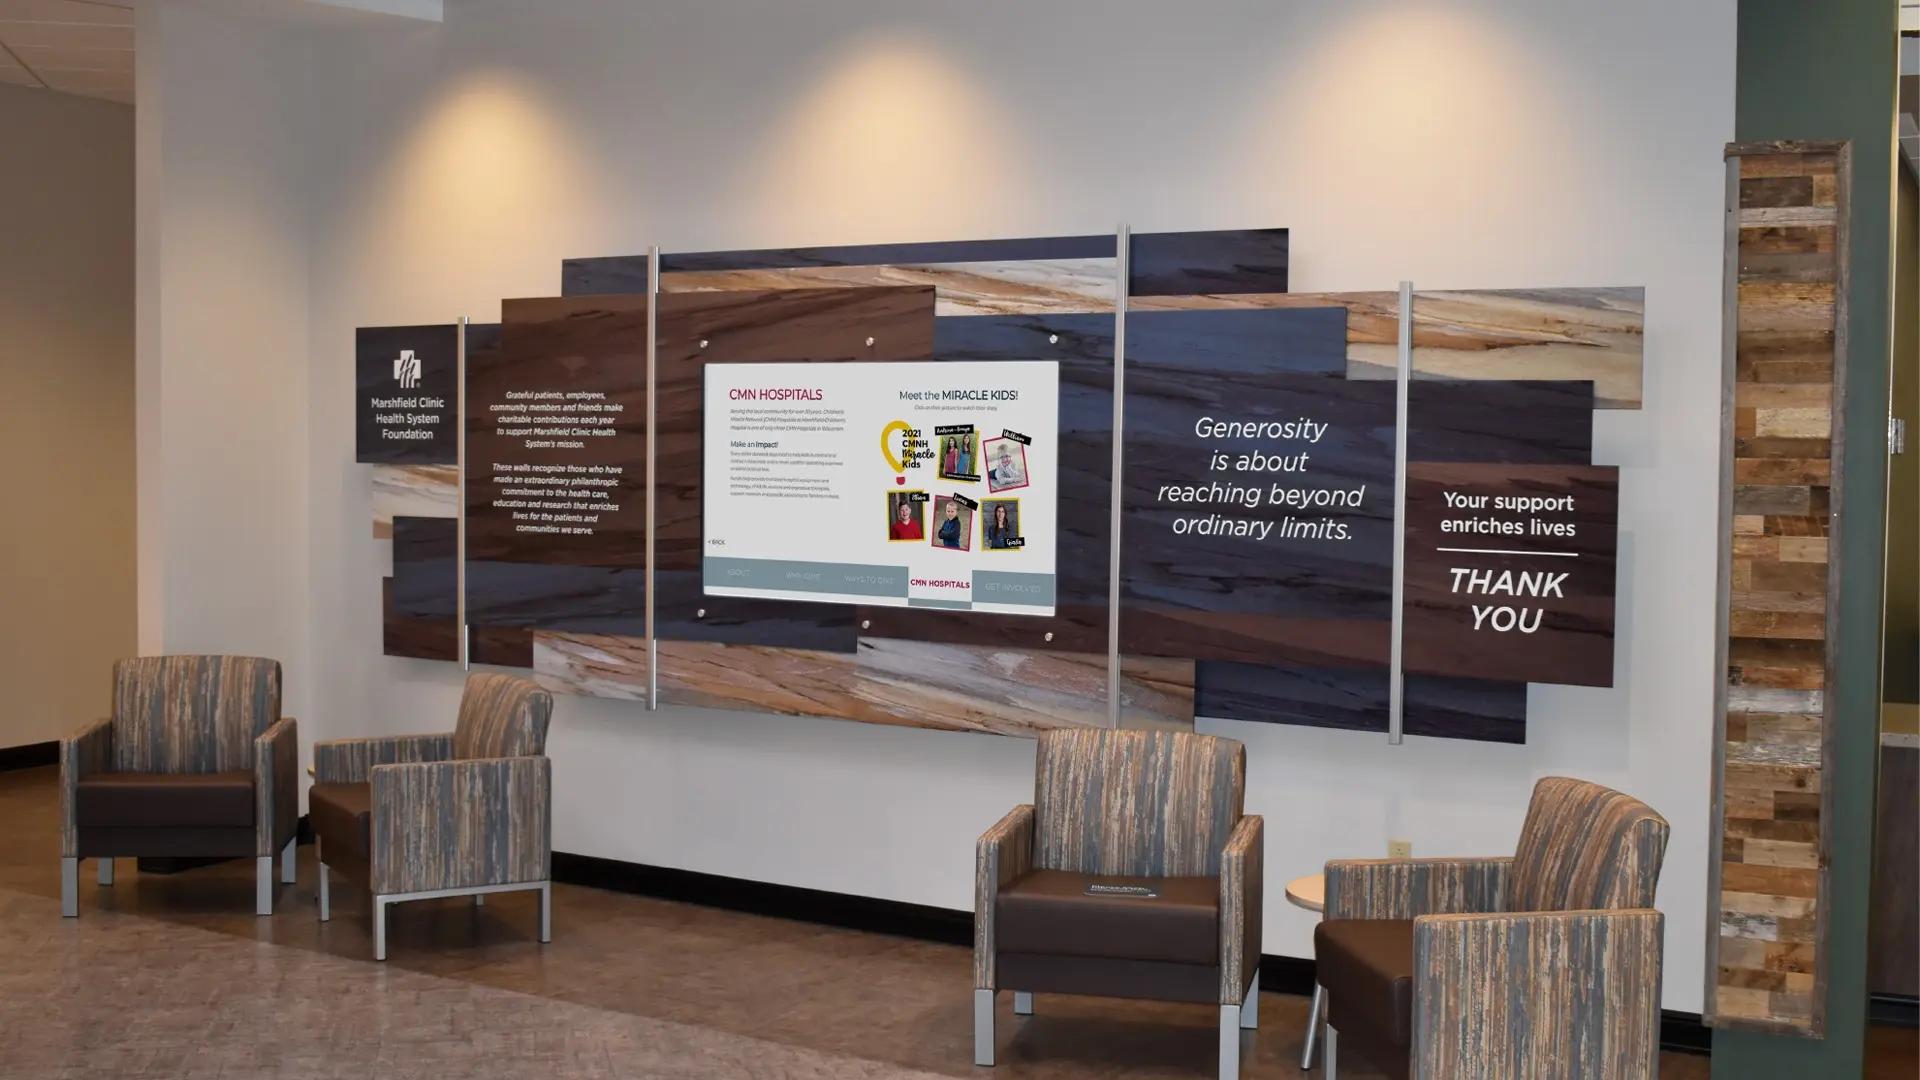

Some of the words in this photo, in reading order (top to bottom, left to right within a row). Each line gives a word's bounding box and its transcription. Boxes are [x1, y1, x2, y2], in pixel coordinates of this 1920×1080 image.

[506, 391, 533, 399] Grateful
[534, 391, 564, 400] patients,
[566, 392, 606, 400] employees,
[729, 389, 756, 400] CMN
[759, 389, 822, 400] HOSPITALS
[900, 391, 922, 400] Meet
[925, 391, 939, 400] the
[942, 390, 988, 400] MIRACLE
[991, 390, 1018, 400] KIDS!
[372, 397, 417, 408] Marshfield
[420, 397, 444, 408] Clinic
[490, 403, 527, 412] community
[376, 413, 404, 423] Health
[407, 413, 440, 425] System
[599, 417, 615, 425] year
[382, 429, 433, 439] Foundation
[506, 428, 532, 437] support
[571, 428, 590, 436] Clinic
[592, 428, 616, 436] Health
[902, 429, 921, 437] 2021
[1195, 417, 1328, 443] Generosity
[525, 440, 555, 449] System's
[557, 440, 584, 448] mission.
[902, 440, 928, 448] CMNH
[902, 449, 935, 460] Miracle
[1210, 450, 1229, 471] is
[1236, 450, 1309, 472] about
[493, 463, 512, 471] These
[514, 464, 530, 472] walls
[532, 464, 566, 473] recognize
[567, 465, 586, 473] those
[589, 465, 604, 473] who
[605, 466, 622, 474] have
[524, 476, 570, 486] extraordinary
[571, 477, 618, 487] philanthropic
[502, 488, 545, 496] commitment
[555, 489, 567, 497] the
[568, 489, 590, 497] health
[592, 491, 609, 499] care,
[1158, 482, 1261, 508] reaching
[1269, 483, 1365, 509] beyond
[528, 500, 541, 508] and
[542, 501, 572, 509] research
[589, 502, 619, 510] enriches
[1444, 492, 1489, 508] Your
[1494, 495, 1575, 513] support
[512, 512, 528, 520] lives
[530, 512, 540, 520] for
[541, 513, 553, 521] the
[554, 513, 582, 522] patients
[584, 514, 598, 522] and
[516, 525, 559, 533] communities
[573, 526, 593, 534] serve.
[1172, 514, 1274, 540] ordinary
[1280, 516, 1352, 540] limits.
[1441, 517, 1524, 535] enriches
[1531, 518, 1576, 536] lives
[911, 579, 928, 587] CMN
[929, 580, 970, 589] HOSPITALS
[1450, 568, 1569, 598] THANK
[1472, 605, 1543, 633] YOU
